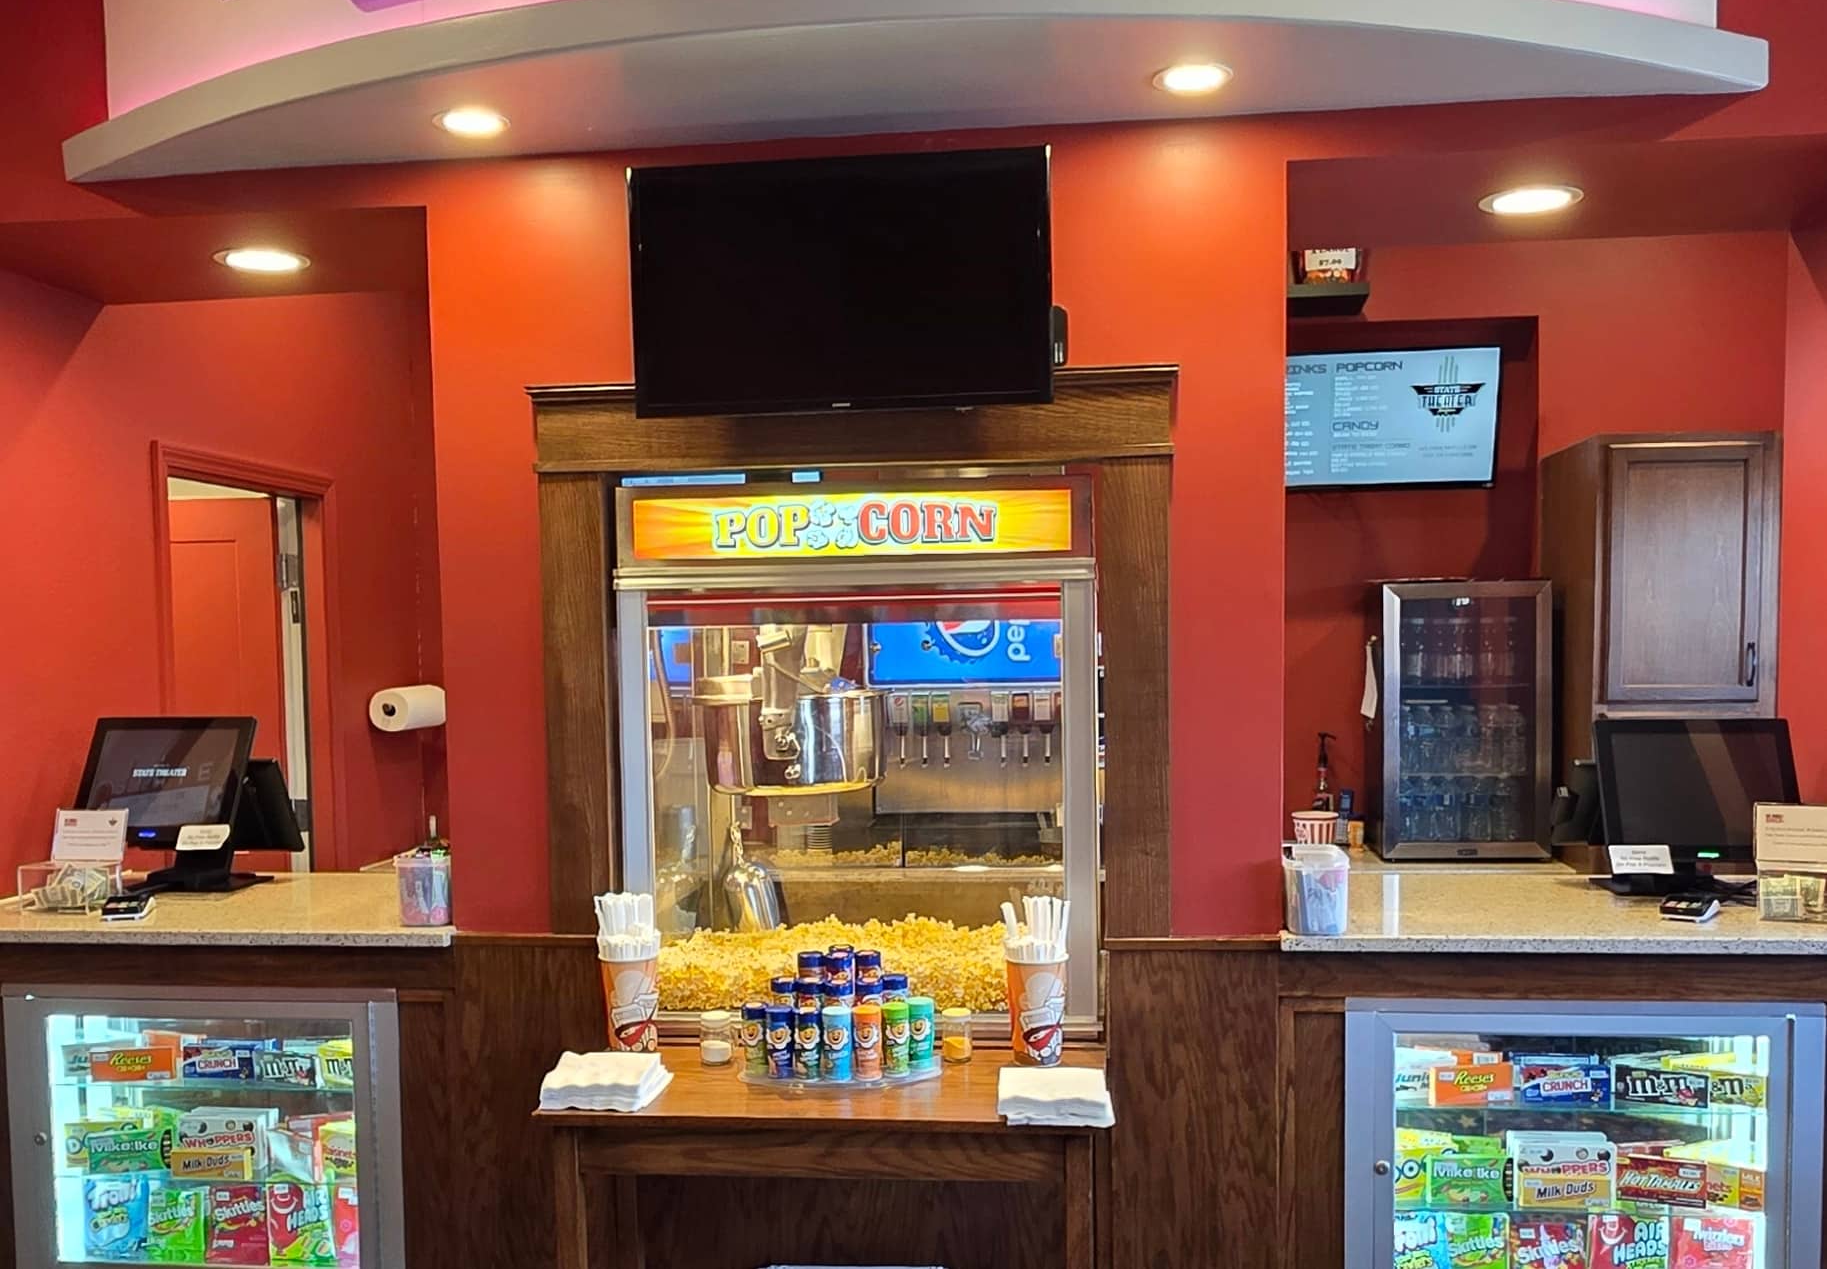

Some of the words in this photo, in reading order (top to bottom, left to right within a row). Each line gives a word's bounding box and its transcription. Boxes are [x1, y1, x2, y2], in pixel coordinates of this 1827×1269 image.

[1336, 360, 1403, 373] POPCORN
[1421, 394, 1474, 409] THEATER
[1332, 420, 1379, 431] CANDY
[715, 503, 811, 549] POP
[858, 500, 997, 545] CORN
[198, 1058, 236, 1070] CRUNCH
[1542, 1080, 1589, 1092] CRUNCH
[184, 1132, 254, 1149] WHOPPERS
[182, 1157, 202, 1170] Milk
[206, 1155, 230, 1167] Duds
[1536, 1185, 1562, 1199] Milk
[1565, 1181, 1595, 1195] Duds
[214, 1199, 266, 1222] Skittles
[1449, 1234, 1505, 1258] Skittles
[1613, 1240, 1667, 1265] HEADS
